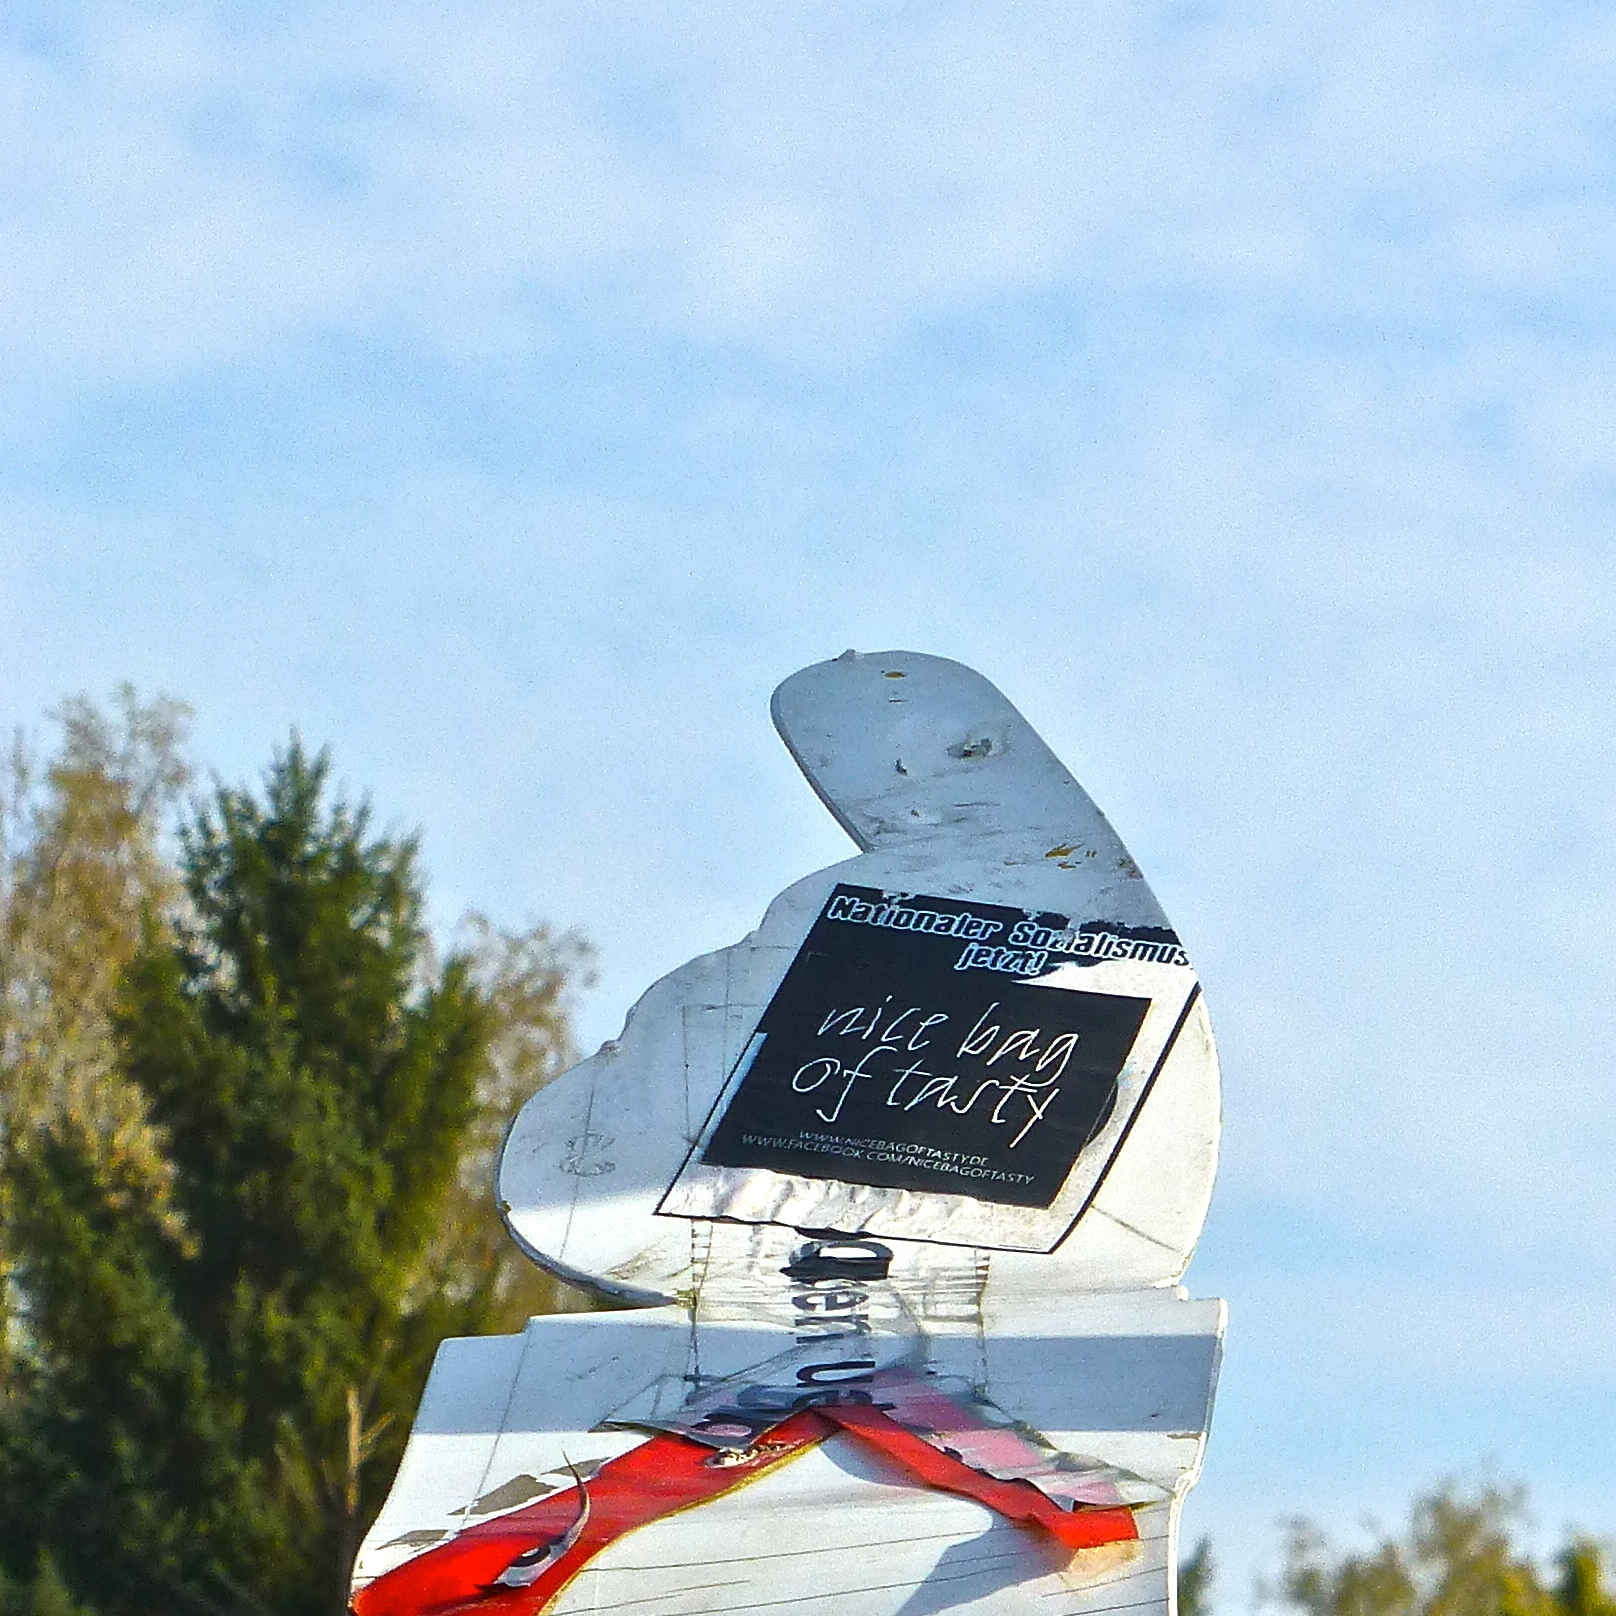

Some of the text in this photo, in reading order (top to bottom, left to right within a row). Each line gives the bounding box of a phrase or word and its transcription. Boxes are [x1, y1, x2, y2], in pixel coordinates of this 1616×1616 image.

[827, 895, 1002, 941] Nationaler
[954, 942, 1048, 976] jetzt!
[817, 994, 1080, 1087] nice bag
[792, 1045, 1061, 1149] of tasty
